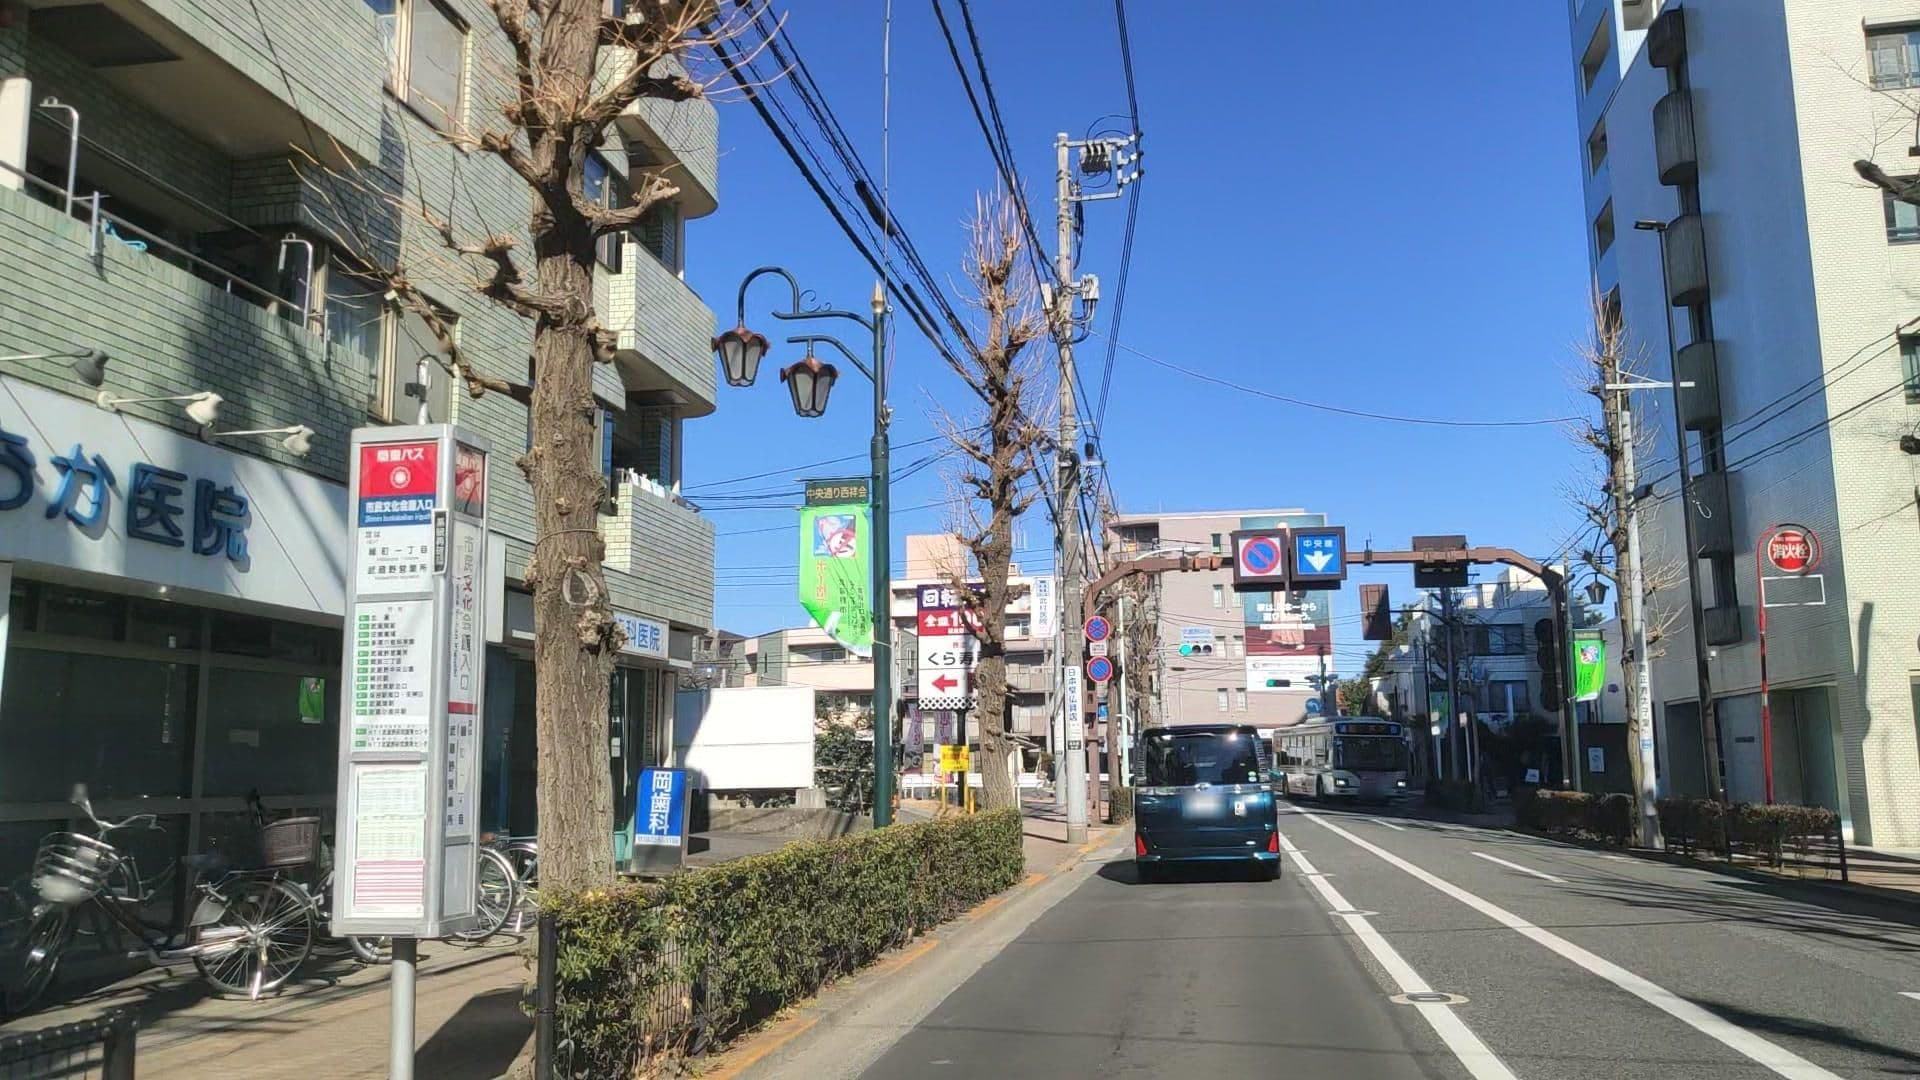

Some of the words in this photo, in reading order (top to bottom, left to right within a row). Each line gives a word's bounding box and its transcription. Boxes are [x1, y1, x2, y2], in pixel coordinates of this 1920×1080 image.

[1772, 544, 1808, 558] 消火栓
[649, 770, 673, 835] 岡歯科
